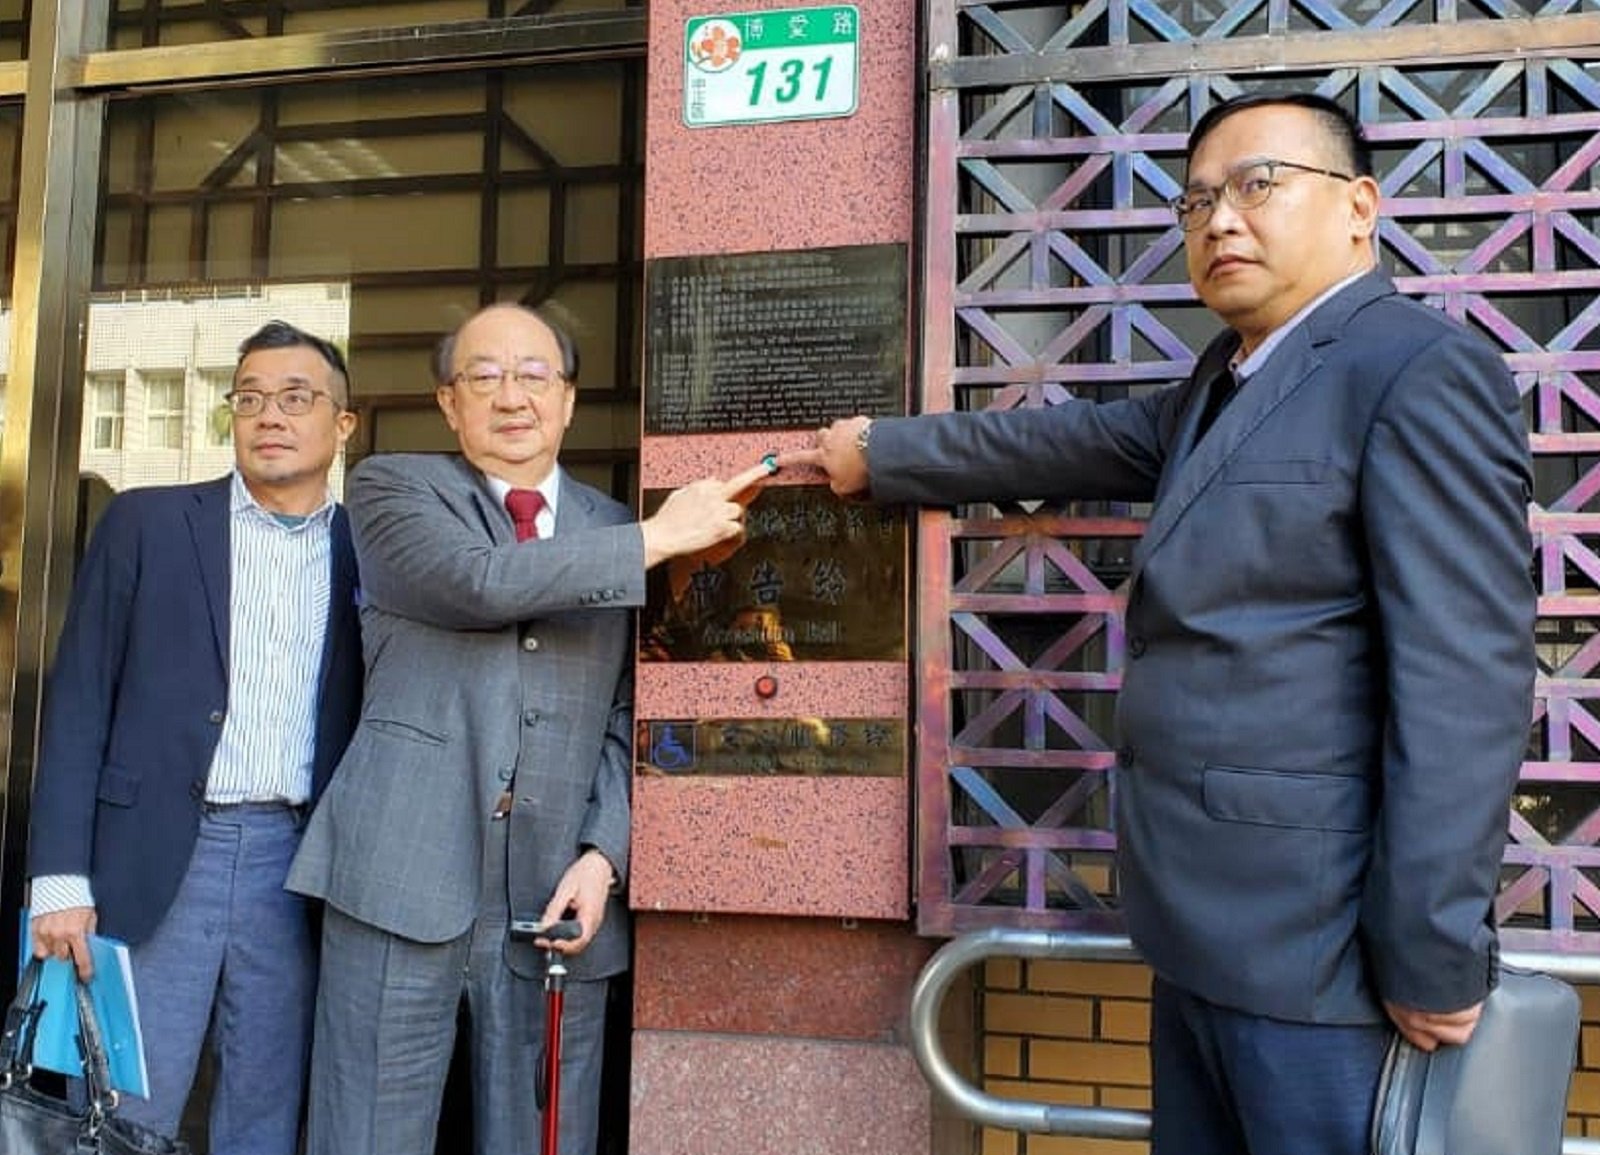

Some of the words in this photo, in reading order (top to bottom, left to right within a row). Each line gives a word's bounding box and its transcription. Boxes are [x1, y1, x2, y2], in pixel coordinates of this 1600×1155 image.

[744, 10, 853, 43] 博愛路
[746, 56, 833, 106] 131
